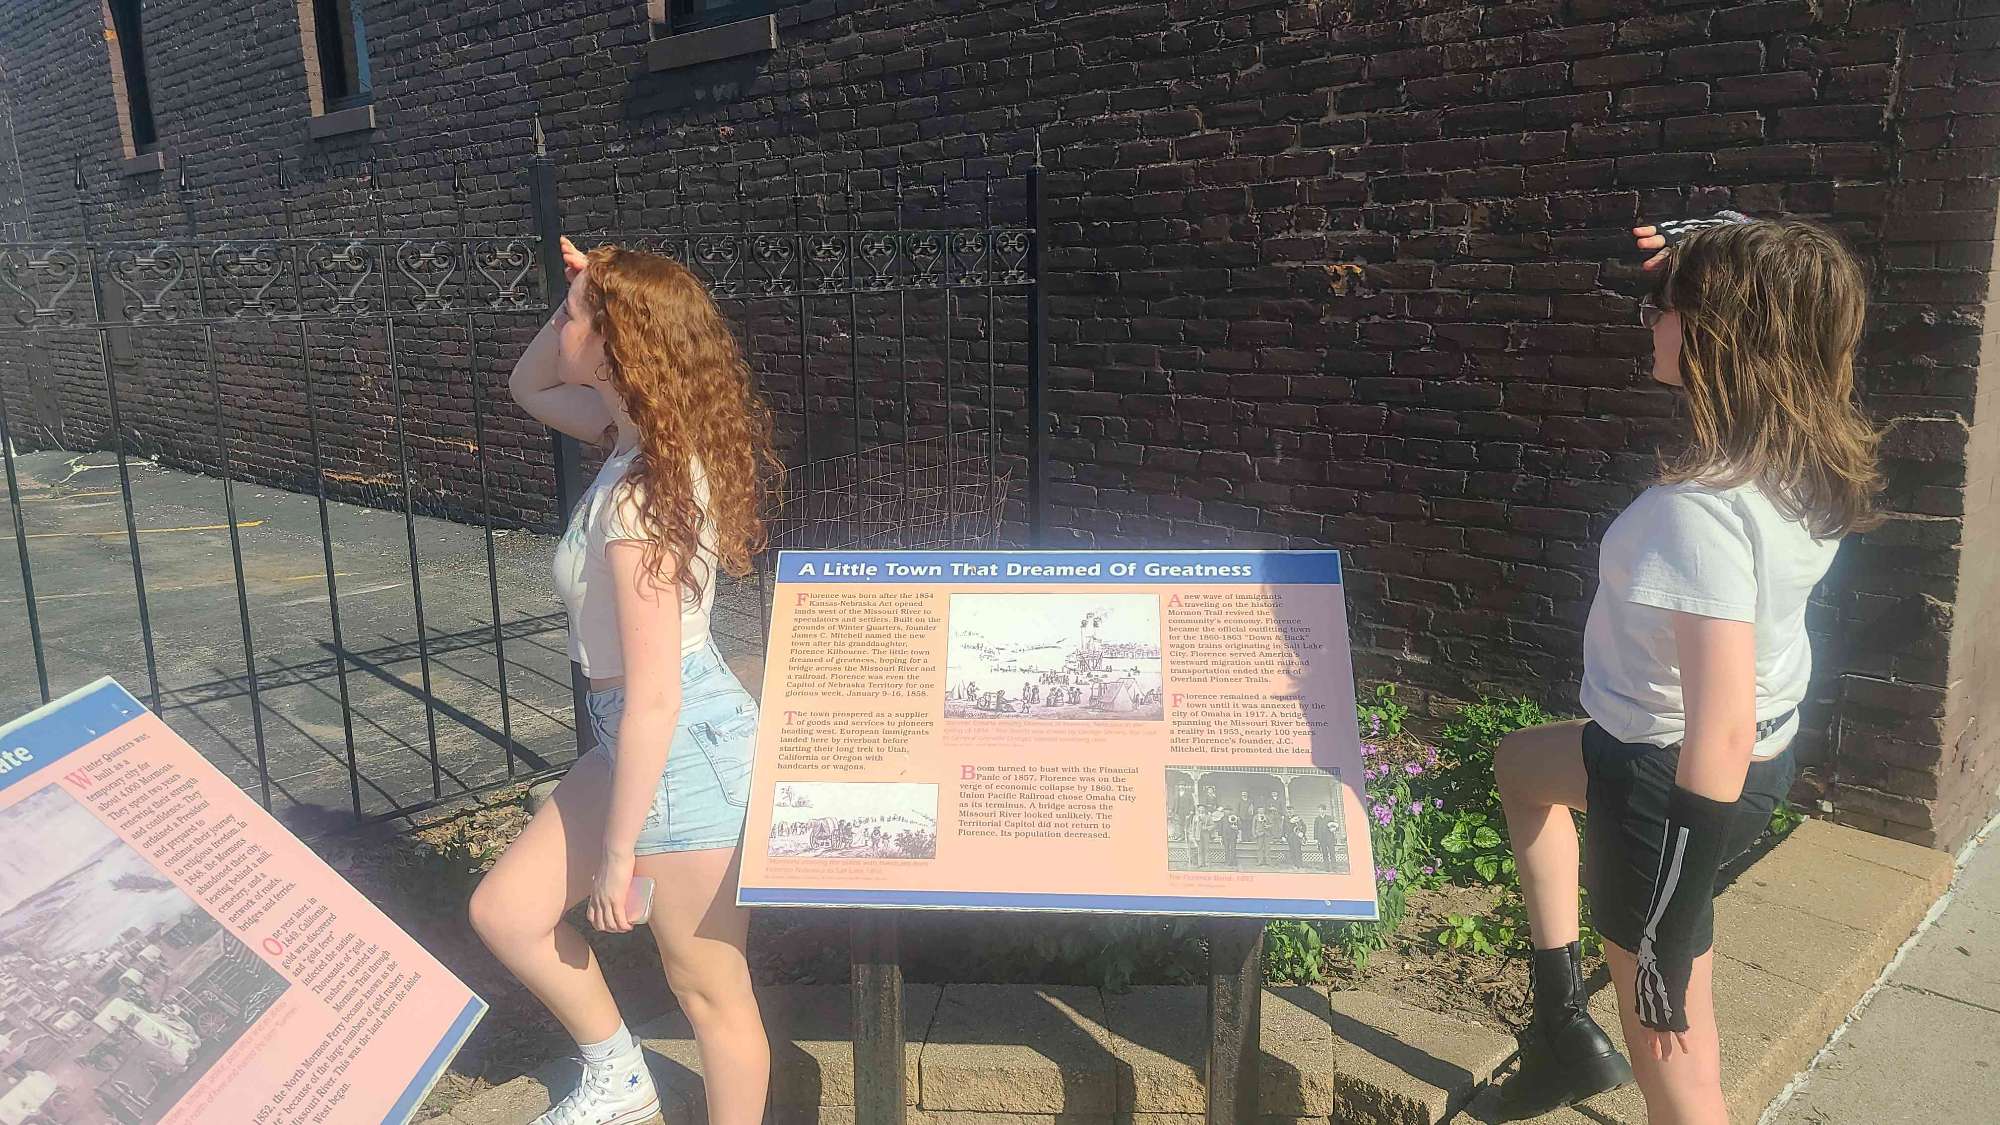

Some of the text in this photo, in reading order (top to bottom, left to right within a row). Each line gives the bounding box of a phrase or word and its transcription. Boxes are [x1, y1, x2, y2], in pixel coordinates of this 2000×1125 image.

[798, 562, 1252, 577] A Little Town That Dreamed Of Greatness
[1235, 593, 1282, 601] immigrants
[894, 600, 923, 608] opened
[1184, 601, 1219, 609] traveling
[794, 616, 839, 624] speculators
[792, 624, 825, 633] grounds
[1248, 626, 1287, 634] outfitting
[1224, 642, 1270, 651] originating
[1190, 650, 1226, 658] Florence
[1229, 650, 1256, 658] served
[879, 657, 908, 665] hoping
[1211, 659, 1251, 667] migration
[788, 665, 813, 673] bridge
[1170, 667, 1229, 676] transportation
[786, 681, 814, 690] Capitol
[868, 681, 903, 690] Territory
[785, 689, 879, 698] glorious January
[832, 710, 873, 719] prospered
[894, 711, 928, 719] supplier
[1279, 711, 1307, 719] bridge
[897, 720, 934, 728] pioneers
[1172, 719, 1211, 728] spanning
[1230, 719, 1267, 727] Missouri
[781, 728, 930, 737] heading European immigrants
[1177, 728, 1204, 737] reality
[1244, 728, 1271, 737] nearly
[101, 740, 137, 763] Quarters
[779, 745, 811, 754] starting
[1231, 746, 1272, 755] promoted
[832, 754, 862, 763] Oregon
[92, 767, 115, 782] built
[84, 776, 127, 804] temporary
[126, 772, 184, 810] spent years
[1039, 784, 1074, 792] collapse
[95, 794, 121, 812] about
[117, 776, 200, 832] renewing their strength
[1038, 802, 1065, 811] bridge
[139, 799, 210, 849] ordained President
[1004, 821, 1034, 829] Capitol
[1071, 821, 1098, 829] return
[164, 823, 199, 850] prepared
[1014, 830, 1061, 839] population
[161, 812, 237, 868] continue their journey
[214, 836, 247, 862] Mormons
[181, 845, 215, 872] religious
[193, 852, 248, 896] abandoned their
[204, 864, 253, 906] leaving behind
[226, 897, 256, 923] network
[236, 908, 265, 933] bridges
[297, 903, 328, 932] California
[304, 911, 337, 944] discovered
[345, 952, 370, 977] traveled
[300, 959, 328, 986] infected
[311, 959, 345, 995] Thousands
[331, 948, 392, 1013] Mormon Trail through
[378, 998, 398, 1020] where
[402, 970, 421, 991] fabled
[283, 976, 383, 1091] North Mormon Ferry became known
[282, 971, 404, 1115] because large numbers rushers
